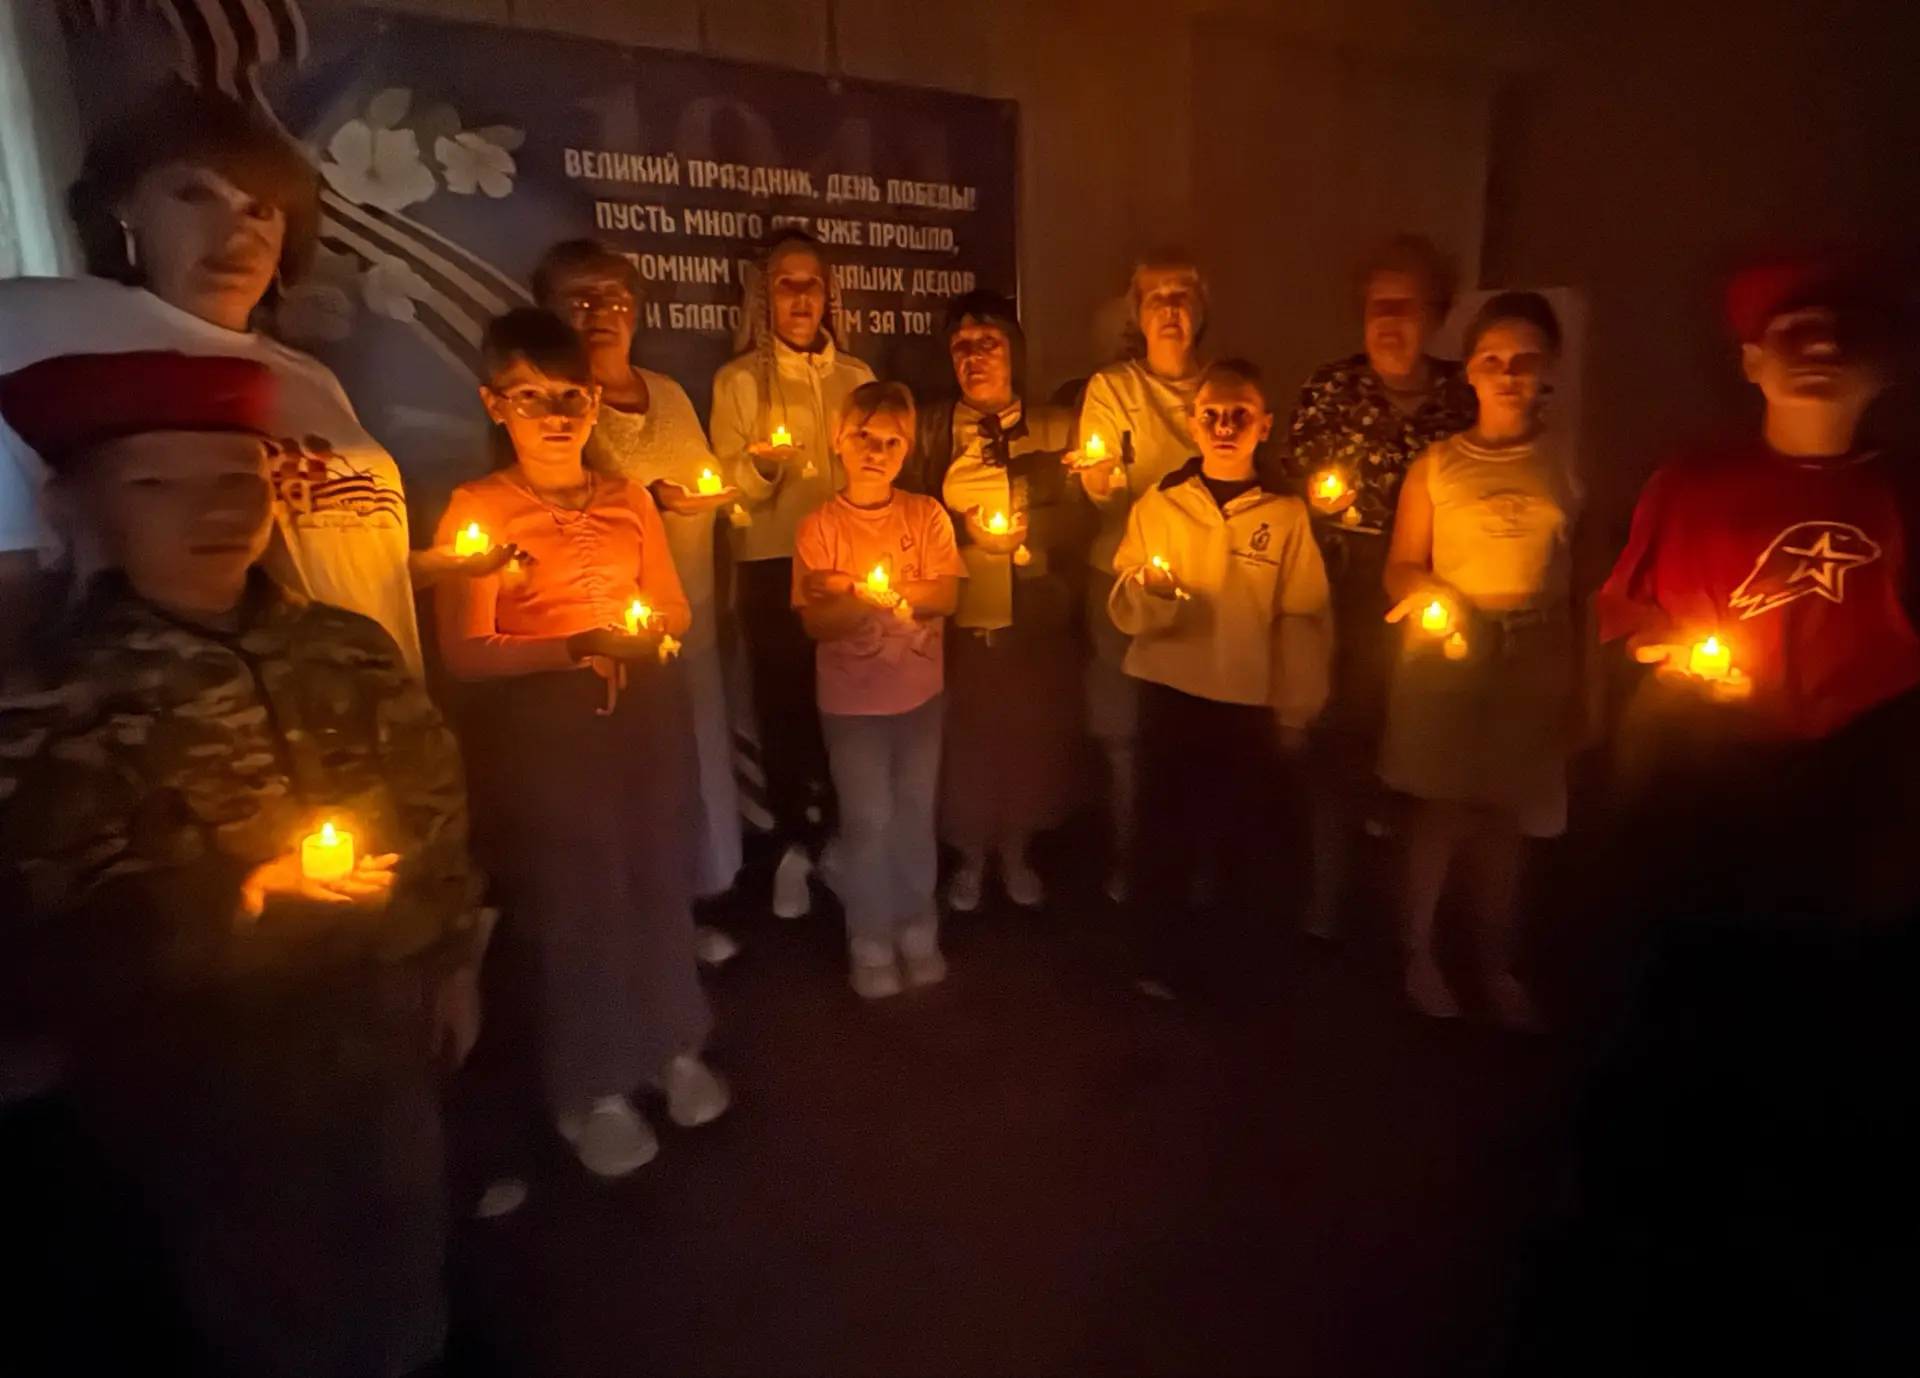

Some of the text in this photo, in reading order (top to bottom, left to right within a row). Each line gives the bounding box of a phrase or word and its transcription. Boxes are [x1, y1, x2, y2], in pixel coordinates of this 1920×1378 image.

[564, 148, 680, 186] ВЕЛИКИЙ
[826, 173, 880, 206] ДЕНЬ
[887, 179, 976, 212] ПОБЕДЫ!
[595, 201, 676, 233] ПУСТЬ
[684, 208, 763, 239] МНОГО
[816, 218, 862, 245] УЖЕ
[912, 269, 976, 298] ДЕДОВ
[645, 302, 661, 329] И
[869, 310, 896, 334] ЗА
[901, 311, 932, 335] ТО!
